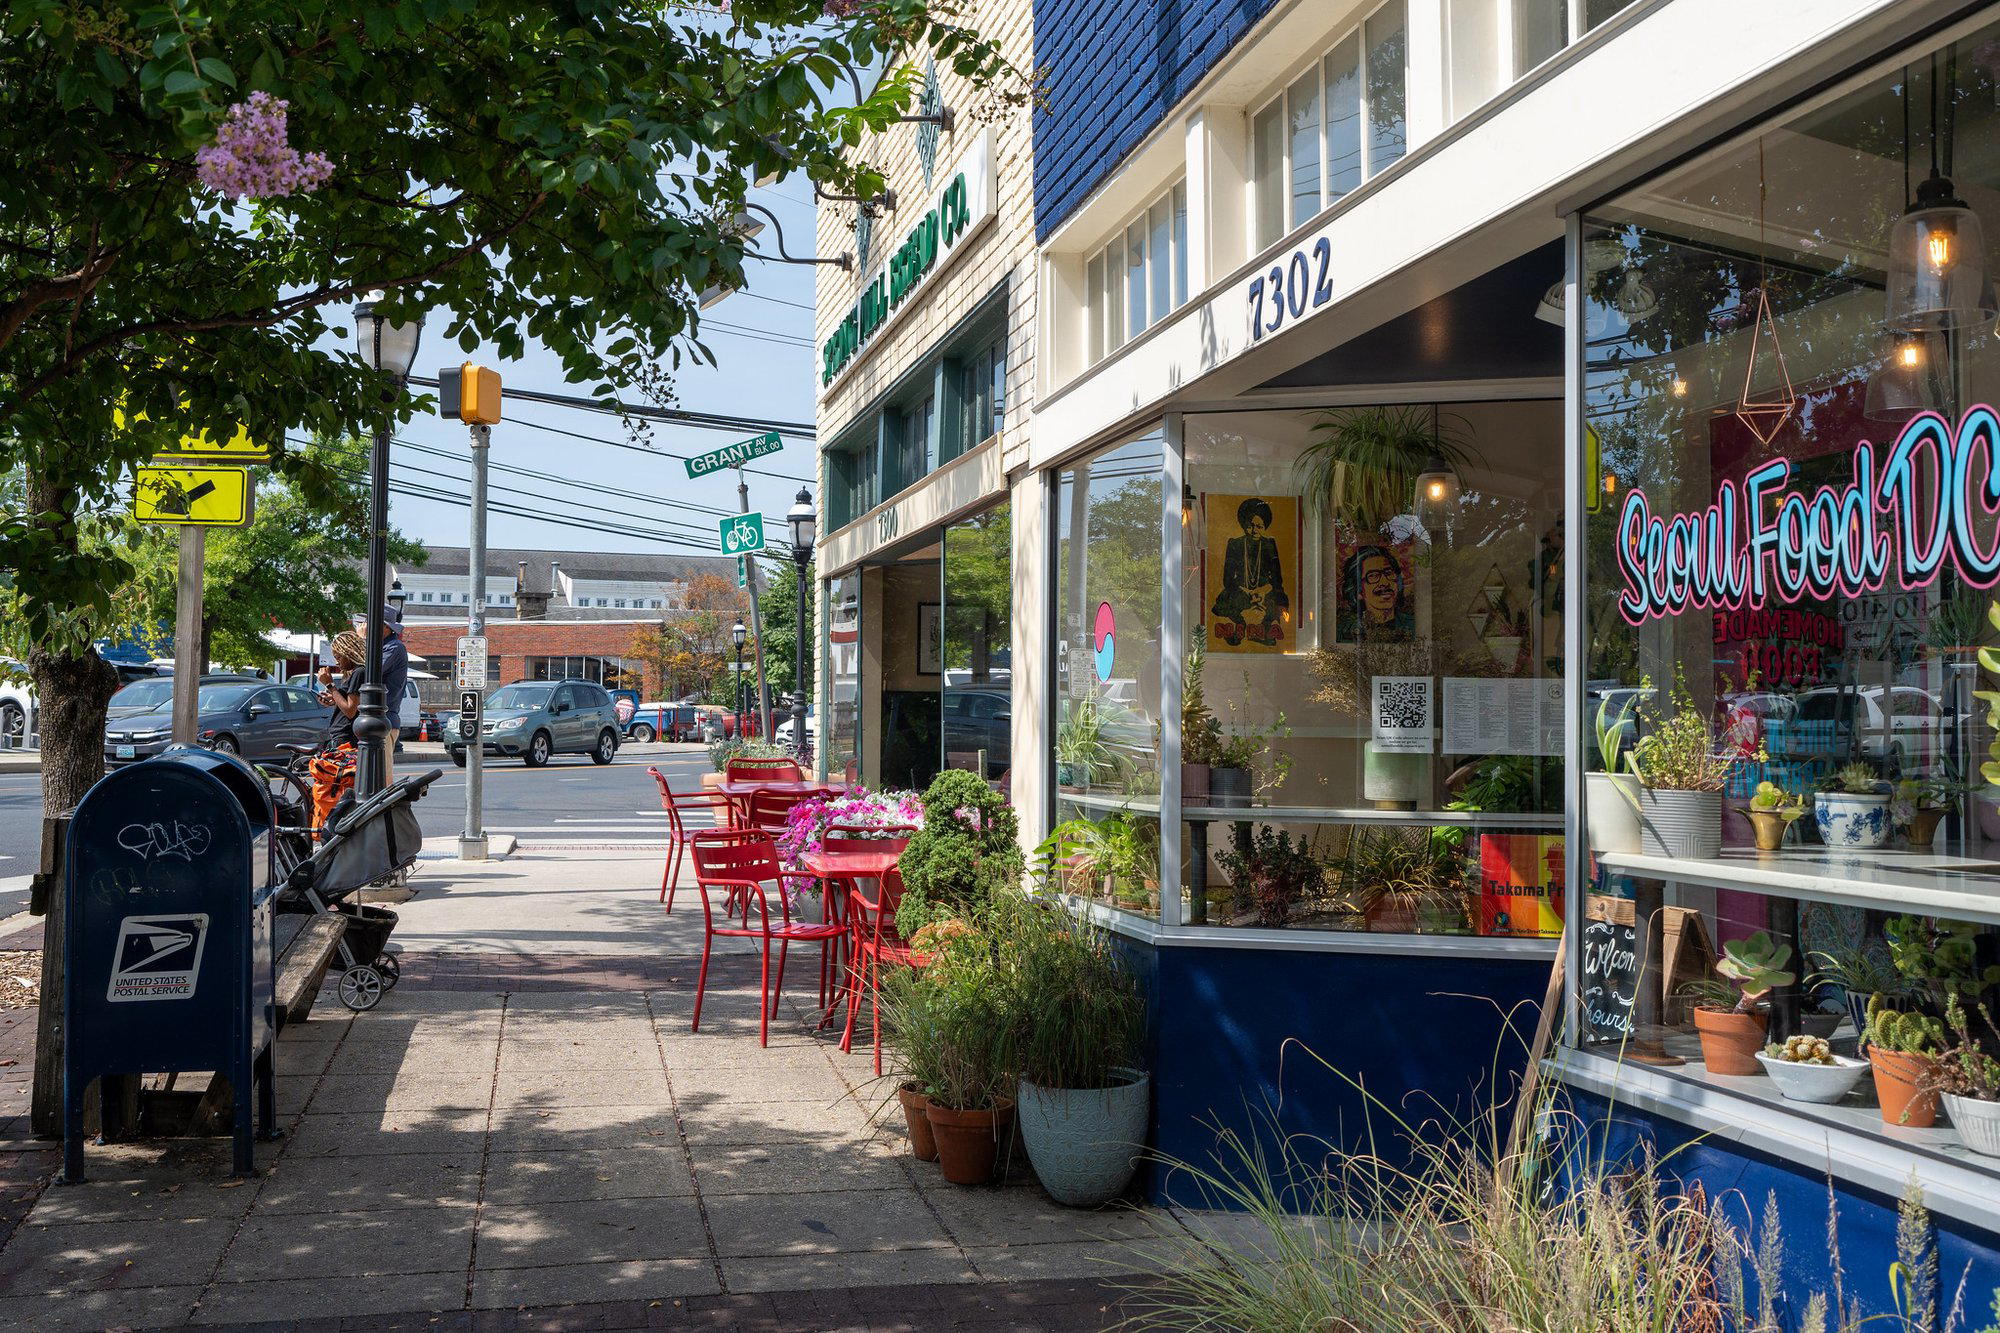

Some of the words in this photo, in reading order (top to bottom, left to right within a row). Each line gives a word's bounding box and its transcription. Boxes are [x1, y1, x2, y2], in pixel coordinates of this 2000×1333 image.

[941, 171, 971, 249] CO.
[1248, 236, 1334, 341] 7302
[690, 441, 753, 473] GRANT
[755, 436, 767, 447] AV
[754, 445, 769, 456] BLK
[878, 506, 898, 544] 7300
[1616, 479, 1749, 627] Seoul
[1744, 438, 1891, 611] Food
[1876, 403, 2000, 590] DC
[1214, 622, 1284, 641] NINA
[1488, 880, 1545, 898] Takoma
[1585, 937, 1636, 979] Welcom
[113, 987, 149, 997] POSTAL
[151, 985, 190, 996] SERVICE
[115, 977, 152, 987] UNITED
[153, 975, 187, 986] STATES
